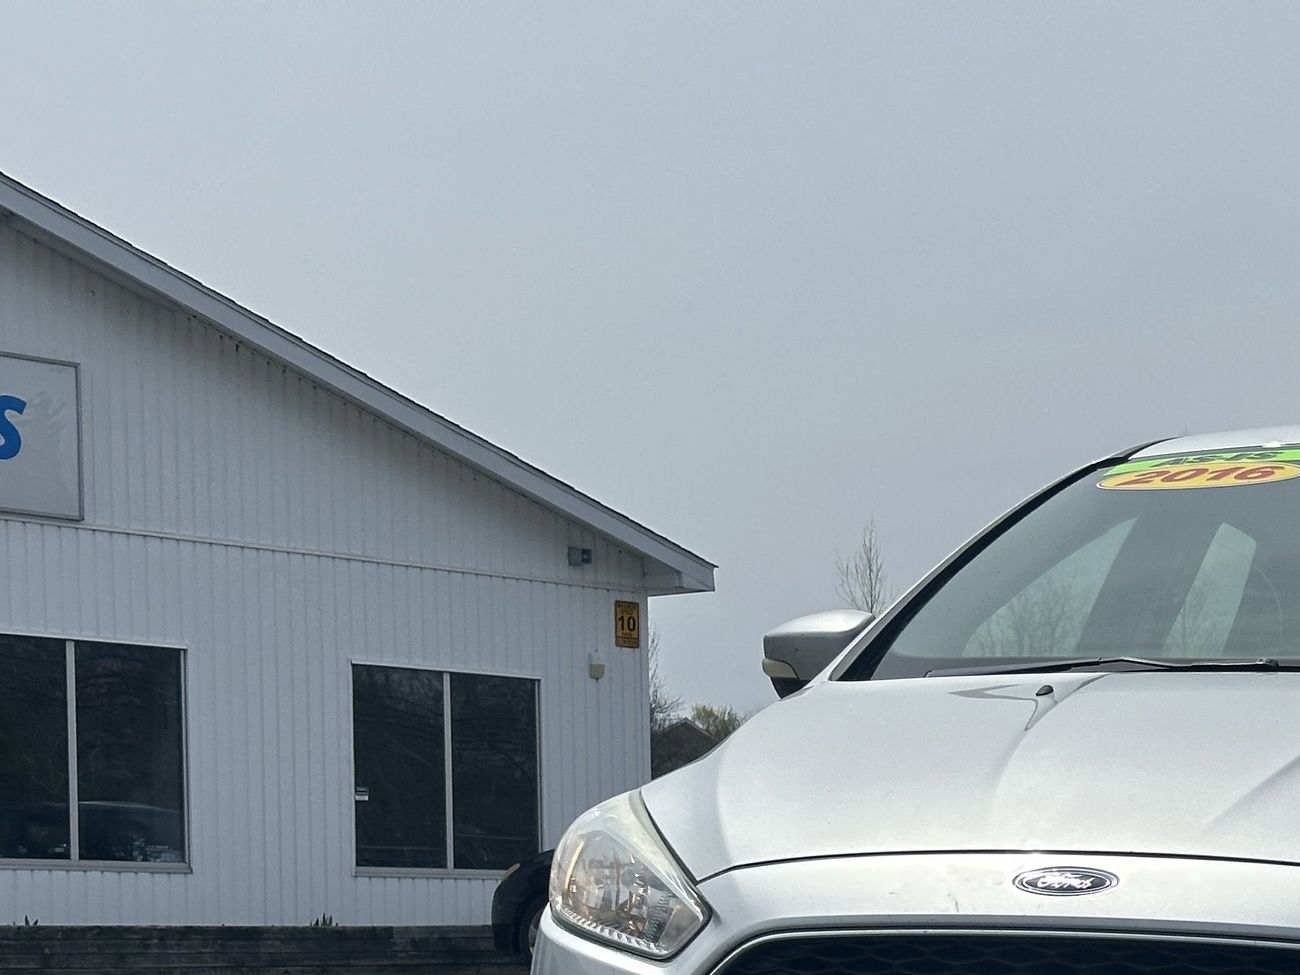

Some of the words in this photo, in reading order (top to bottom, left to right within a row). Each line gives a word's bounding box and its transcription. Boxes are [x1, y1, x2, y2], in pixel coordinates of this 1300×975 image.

[1114, 466, 1286, 487] 2016
[618, 615, 636, 632] 10
[1036, 872, 1096, 889] Ford
